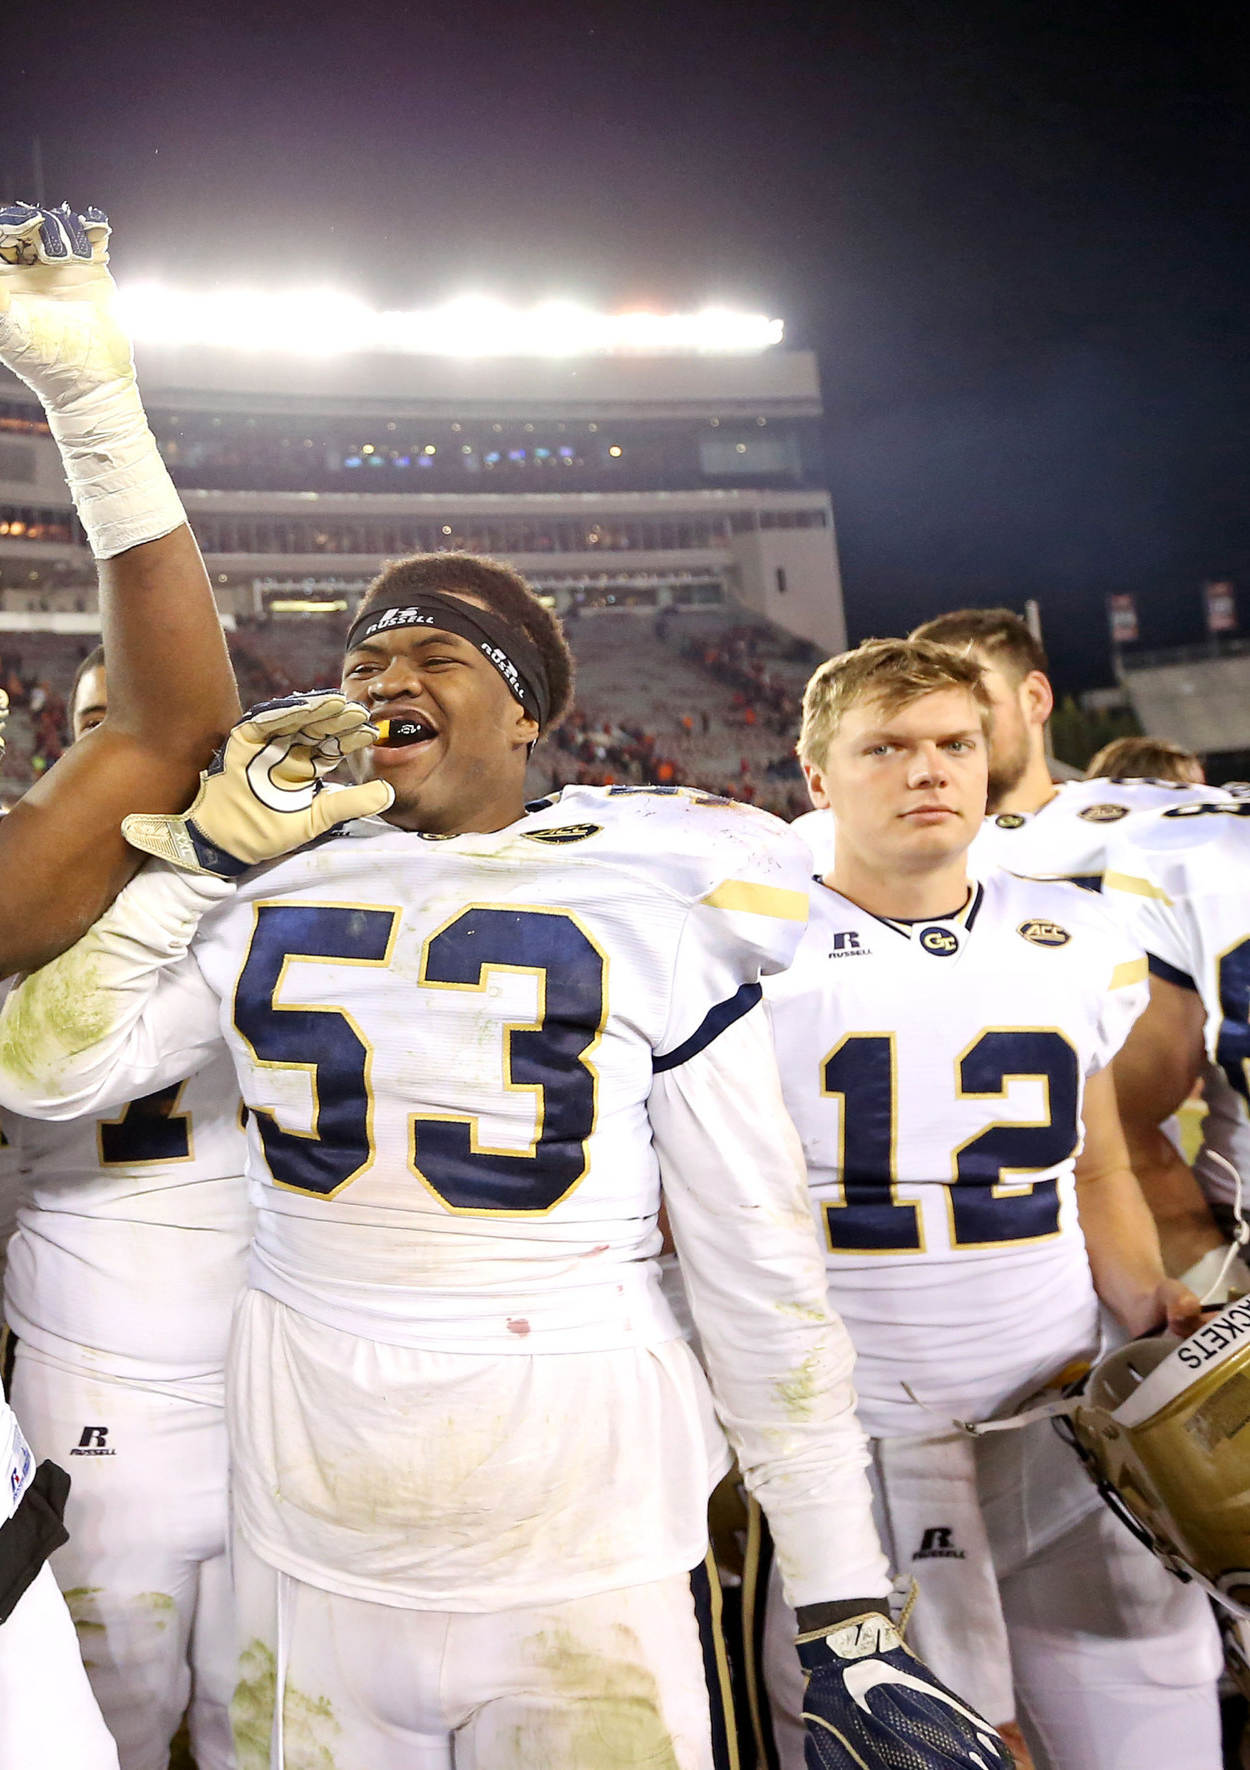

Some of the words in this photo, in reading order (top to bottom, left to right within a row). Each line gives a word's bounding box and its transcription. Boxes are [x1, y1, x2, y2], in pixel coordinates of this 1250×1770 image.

[366, 615, 434, 635] RUSSELL
[481, 643, 525, 698] RUSSELL
[924, 932, 956, 951] GT
[828, 949, 872, 959] RUSSELL
[234, 900, 610, 1216] 53
[820, 1026, 1080, 1254] 12
[70, 1448, 117, 1456] RUSSELL
